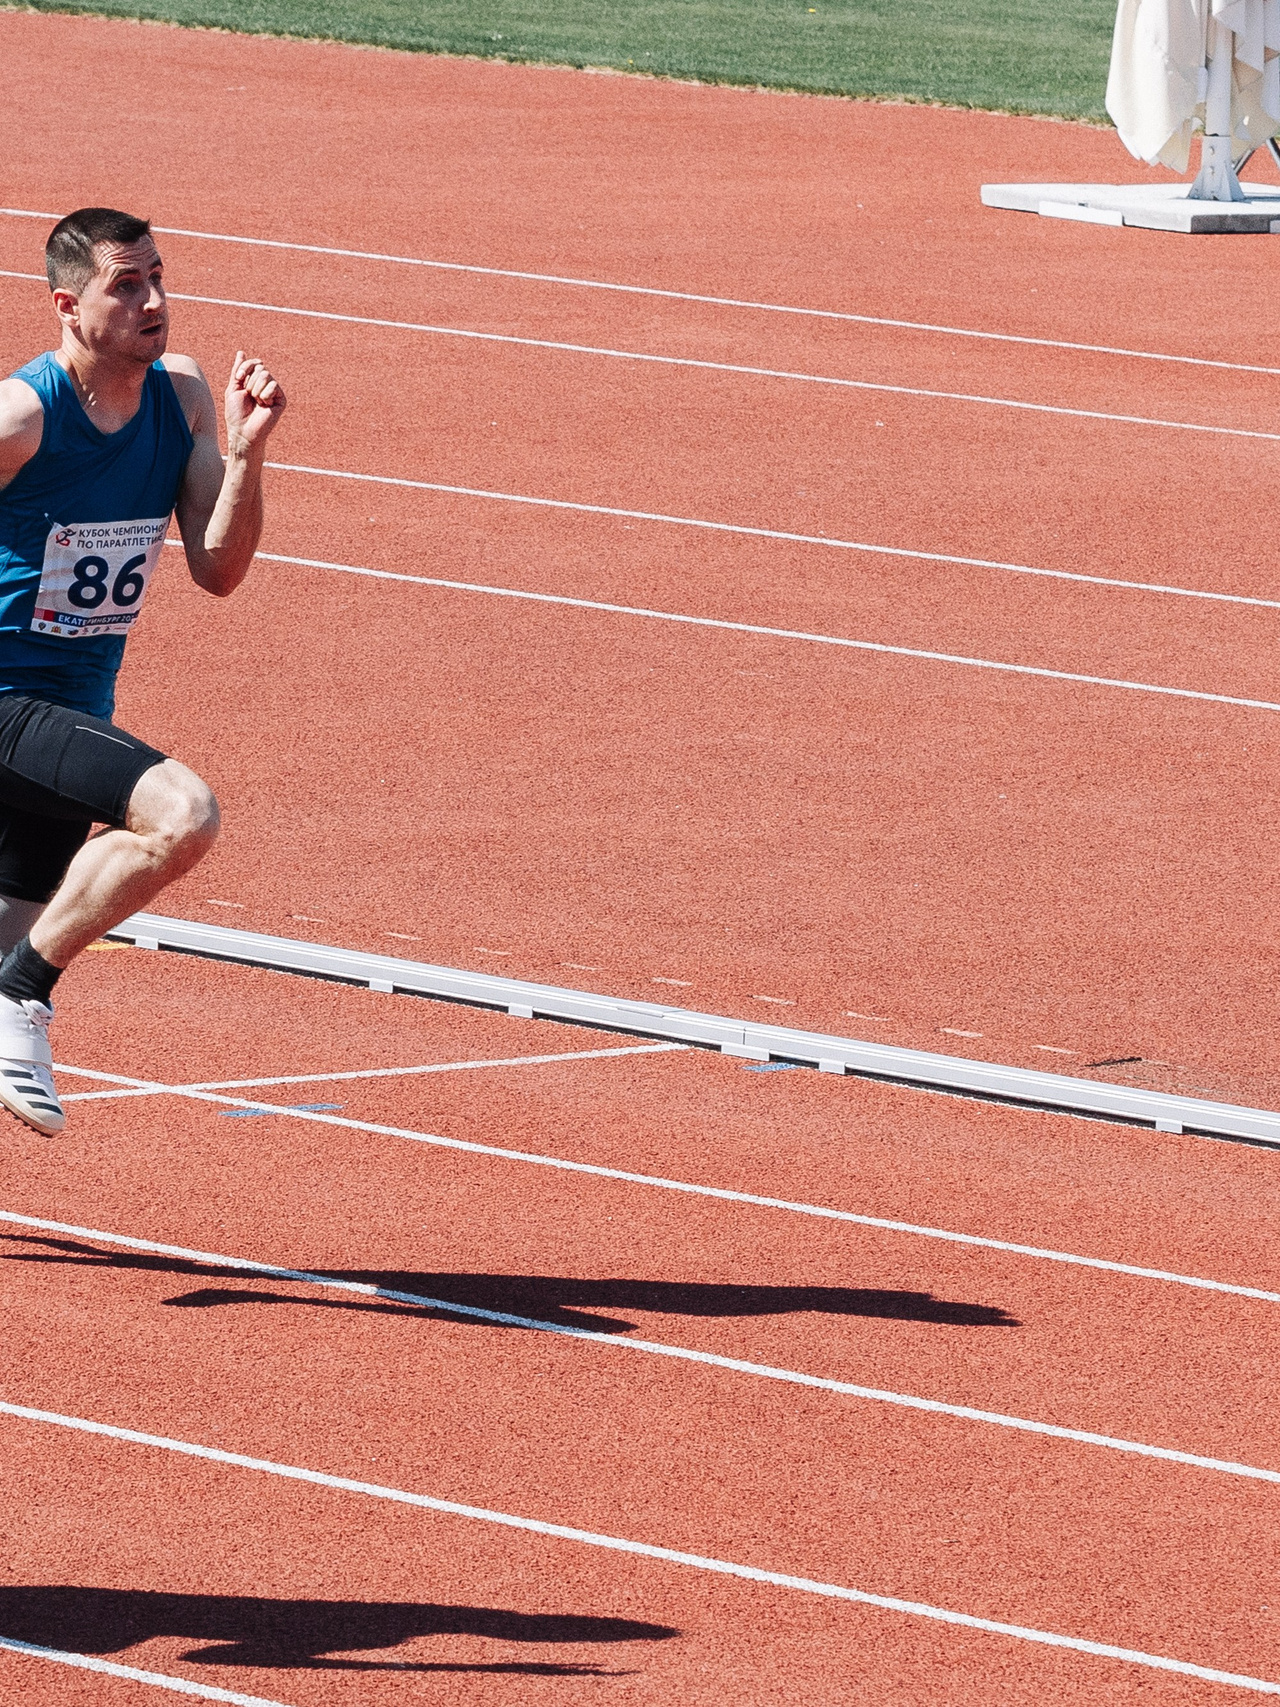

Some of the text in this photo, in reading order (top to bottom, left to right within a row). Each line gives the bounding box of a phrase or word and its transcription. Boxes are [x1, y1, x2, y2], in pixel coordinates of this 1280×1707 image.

[78, 522, 166, 538] КУБОК ЧЕМПИОНО
[76, 540, 94, 549] ПО
[67, 553, 146, 609] 86
